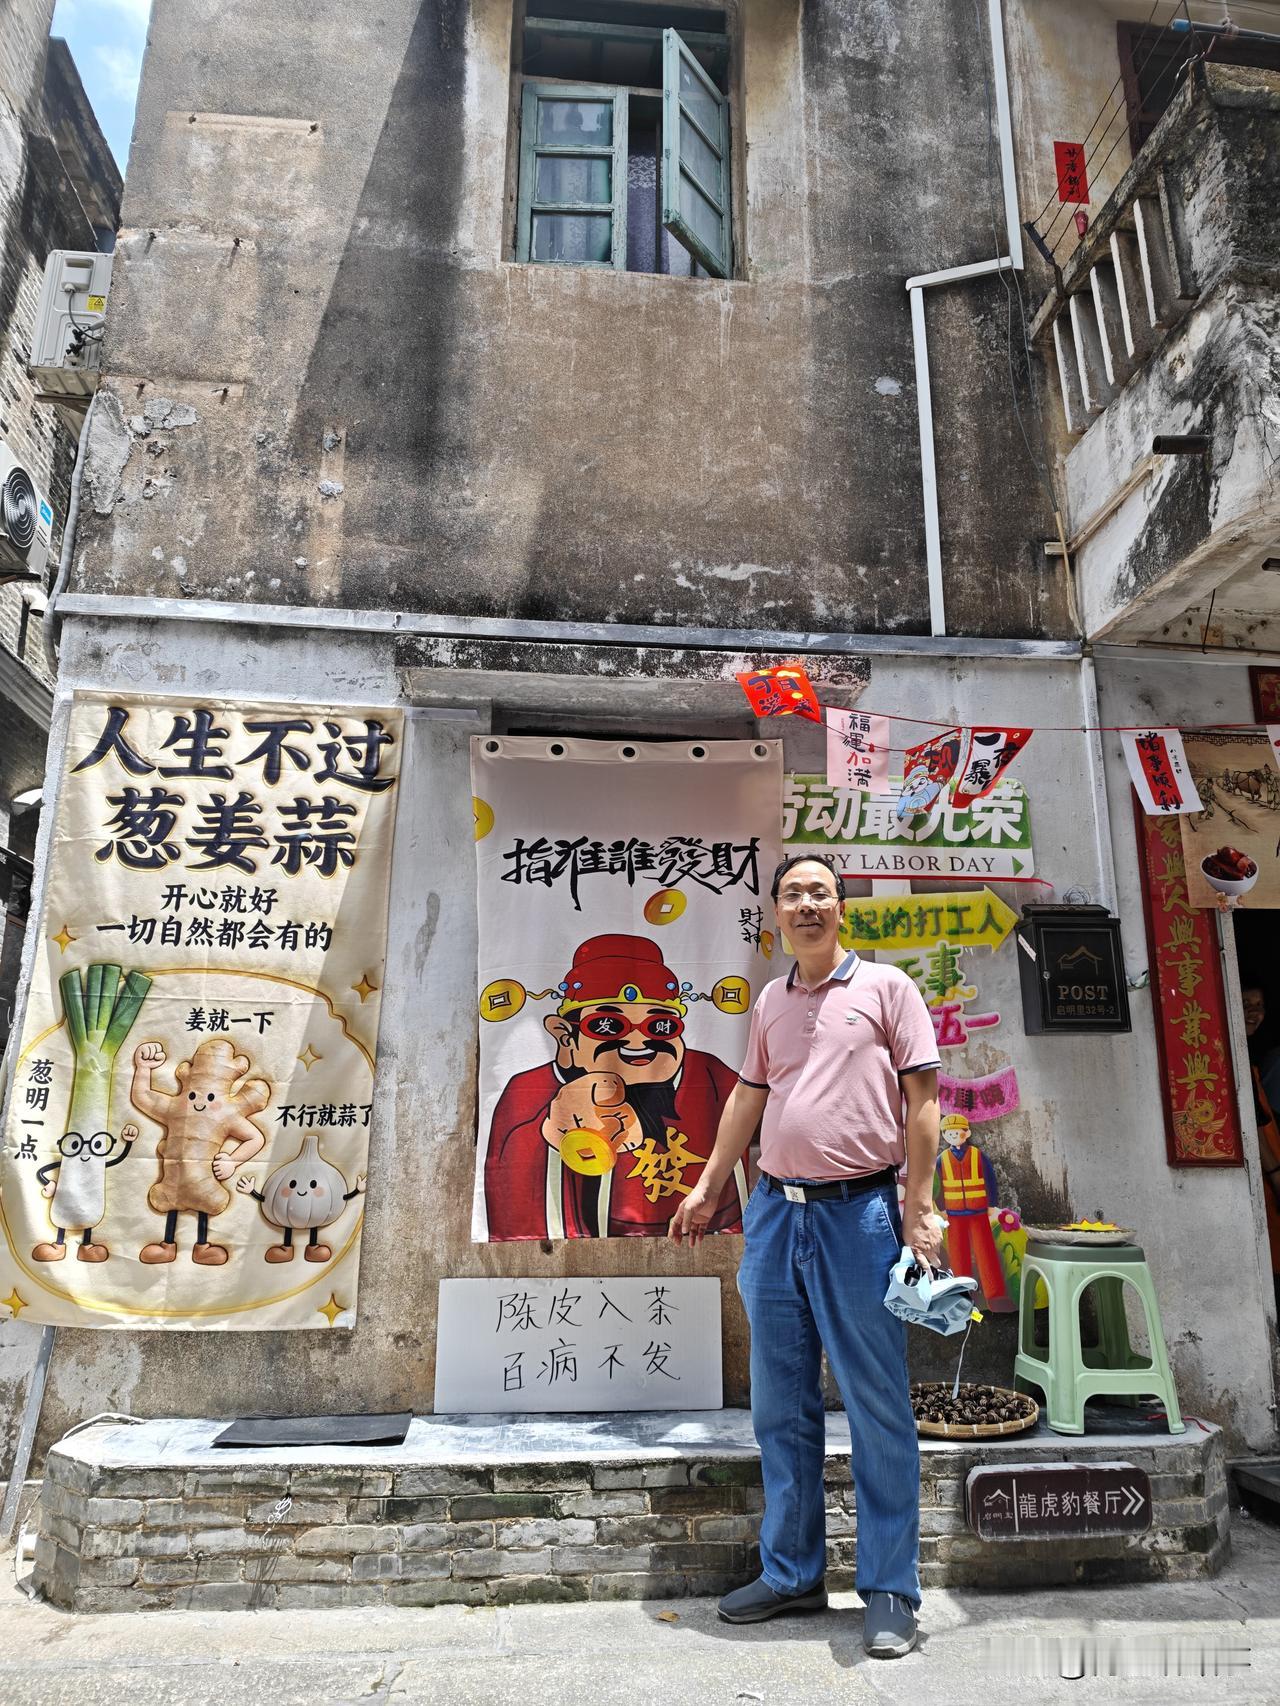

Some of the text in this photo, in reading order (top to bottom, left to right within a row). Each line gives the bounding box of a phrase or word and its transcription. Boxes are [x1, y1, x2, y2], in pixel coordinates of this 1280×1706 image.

[70, 707, 396, 793] 人生不过
[94, 787, 359, 879] 葱姜蒜
[862, 853, 941, 872] LABOR
[949, 856, 997, 874] DAY
[161, 884, 279, 914] 开心就好
[96, 915, 334, 951] 一切自然都会有的
[839, 903, 1003, 940] 起的打工人
[1057, 985, 1109, 1001] POST
[185, 1008, 275, 1034] 姜就一下
[596, 1020, 672, 1034] 发 财
[14, 1059, 54, 1161] 葱明一点
[275, 1103, 373, 1128] 不行就蒜了
[625, 1126, 709, 1203] 發
[496, 1286, 680, 1333] 陈皮入茶
[504, 1338, 681, 1392] 百病不发
[1019, 1490, 1122, 1519] 龍虎豹餐厅
